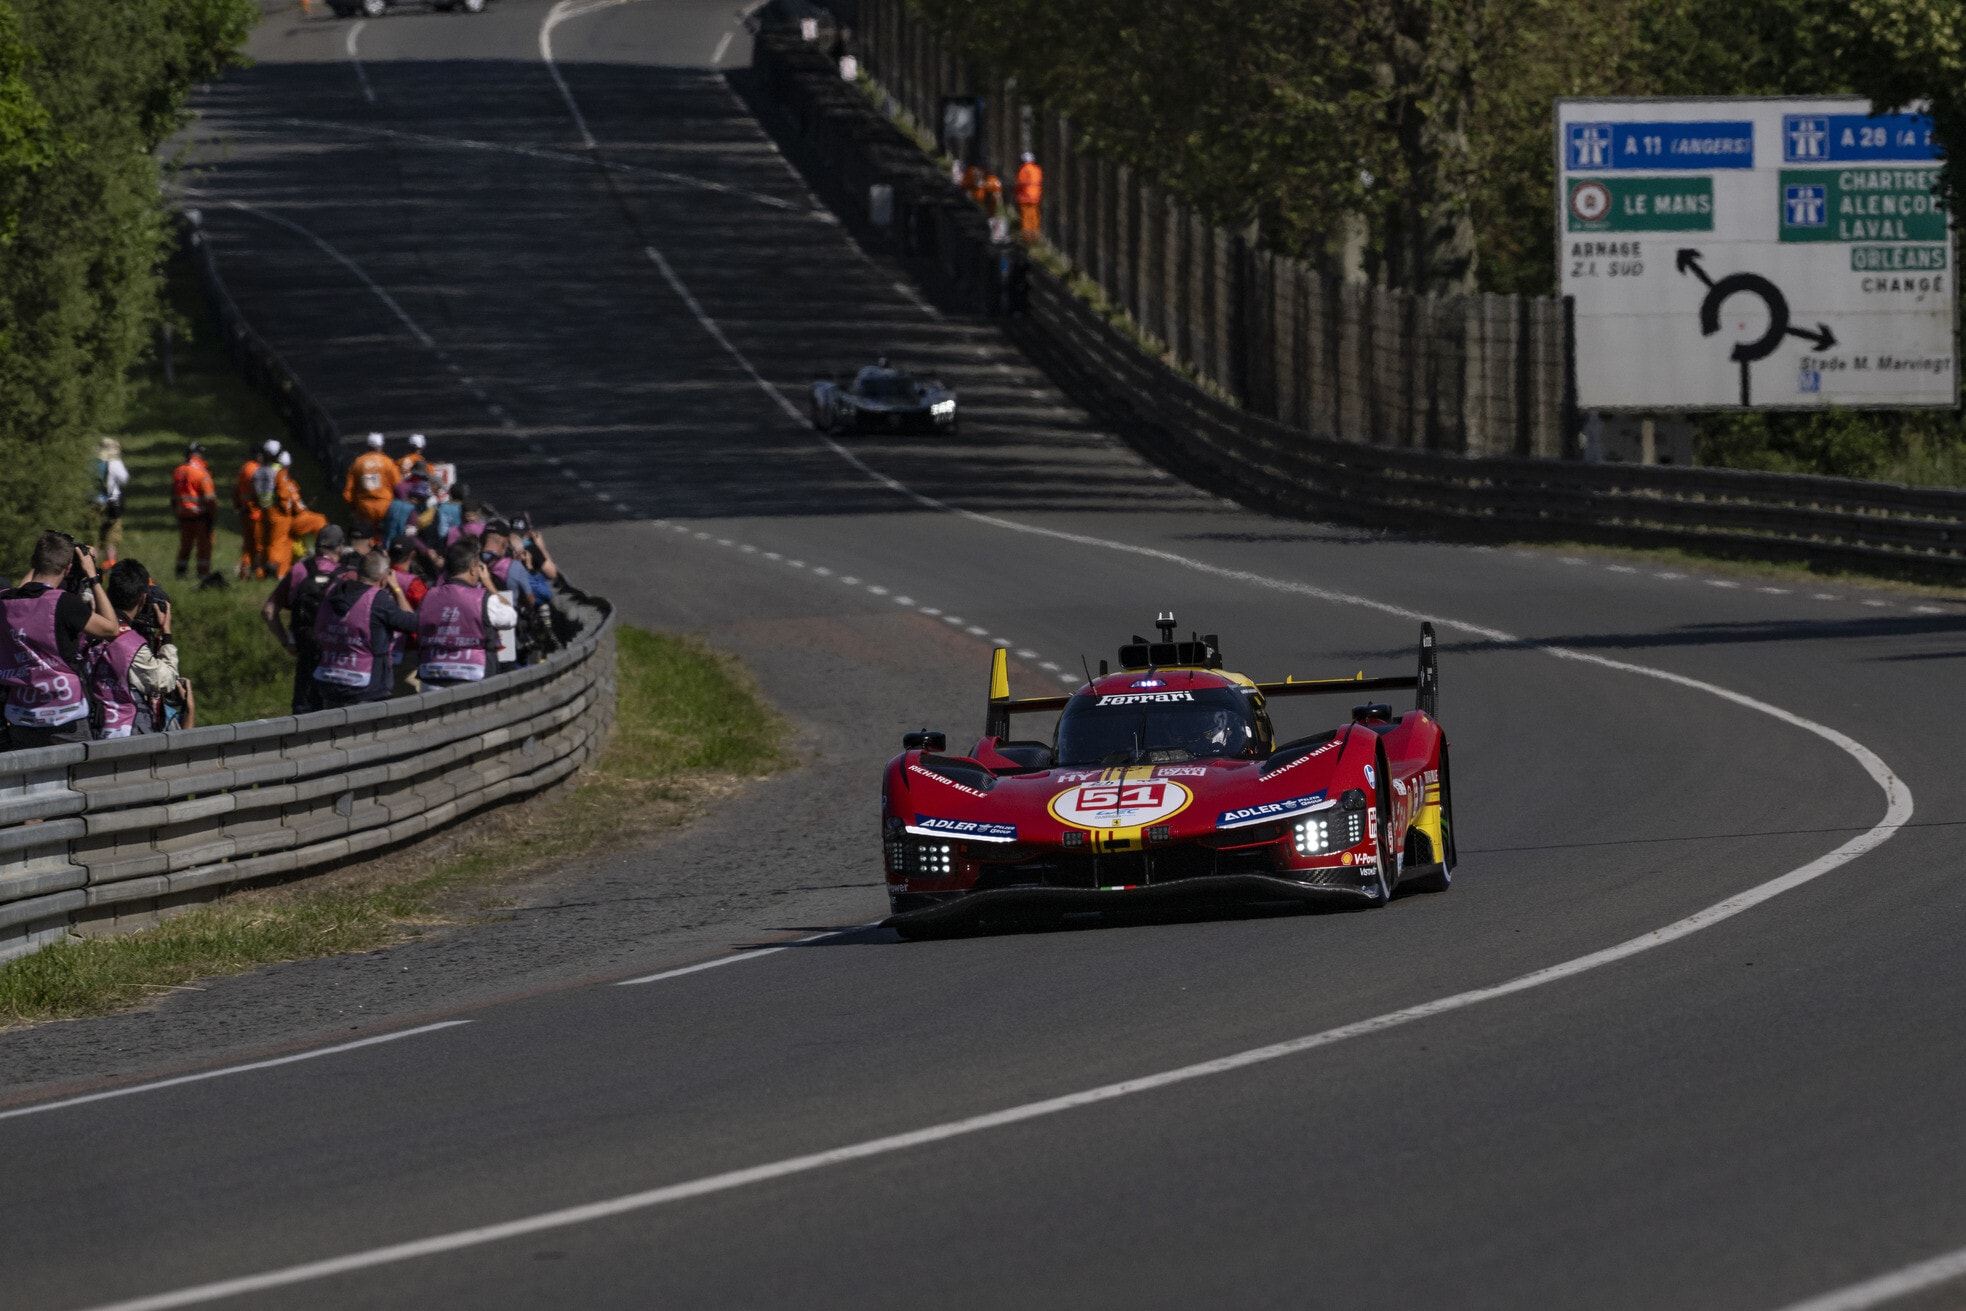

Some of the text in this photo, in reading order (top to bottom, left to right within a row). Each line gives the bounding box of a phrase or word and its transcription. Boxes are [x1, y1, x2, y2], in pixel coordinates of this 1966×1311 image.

[1624, 135, 1752, 155] A 11 (ANGERS)
[1841, 127, 1855, 147] A
[1859, 126, 1887, 147] 28
[1838, 170, 1942, 190] CHARTRES
[1624, 194, 1711, 215] LE MANS
[1838, 219, 1908, 240] LAVAL
[1571, 241, 1642, 257] ARNAGE
[1607, 261, 1644, 277] SUD
[1801, 356, 1847, 371] Stade
[1095, 690, 1195, 706] Ferrari
[1259, 739, 1343, 782] RICHARD MILLE
[908, 764, 988, 798] RICHARD MILLE
[1057, 772, 1093, 783] HY
[1081, 786, 1159, 808] 51
[1224, 803, 1283, 822] ADLER
[920, 818, 976, 831] ADLER
